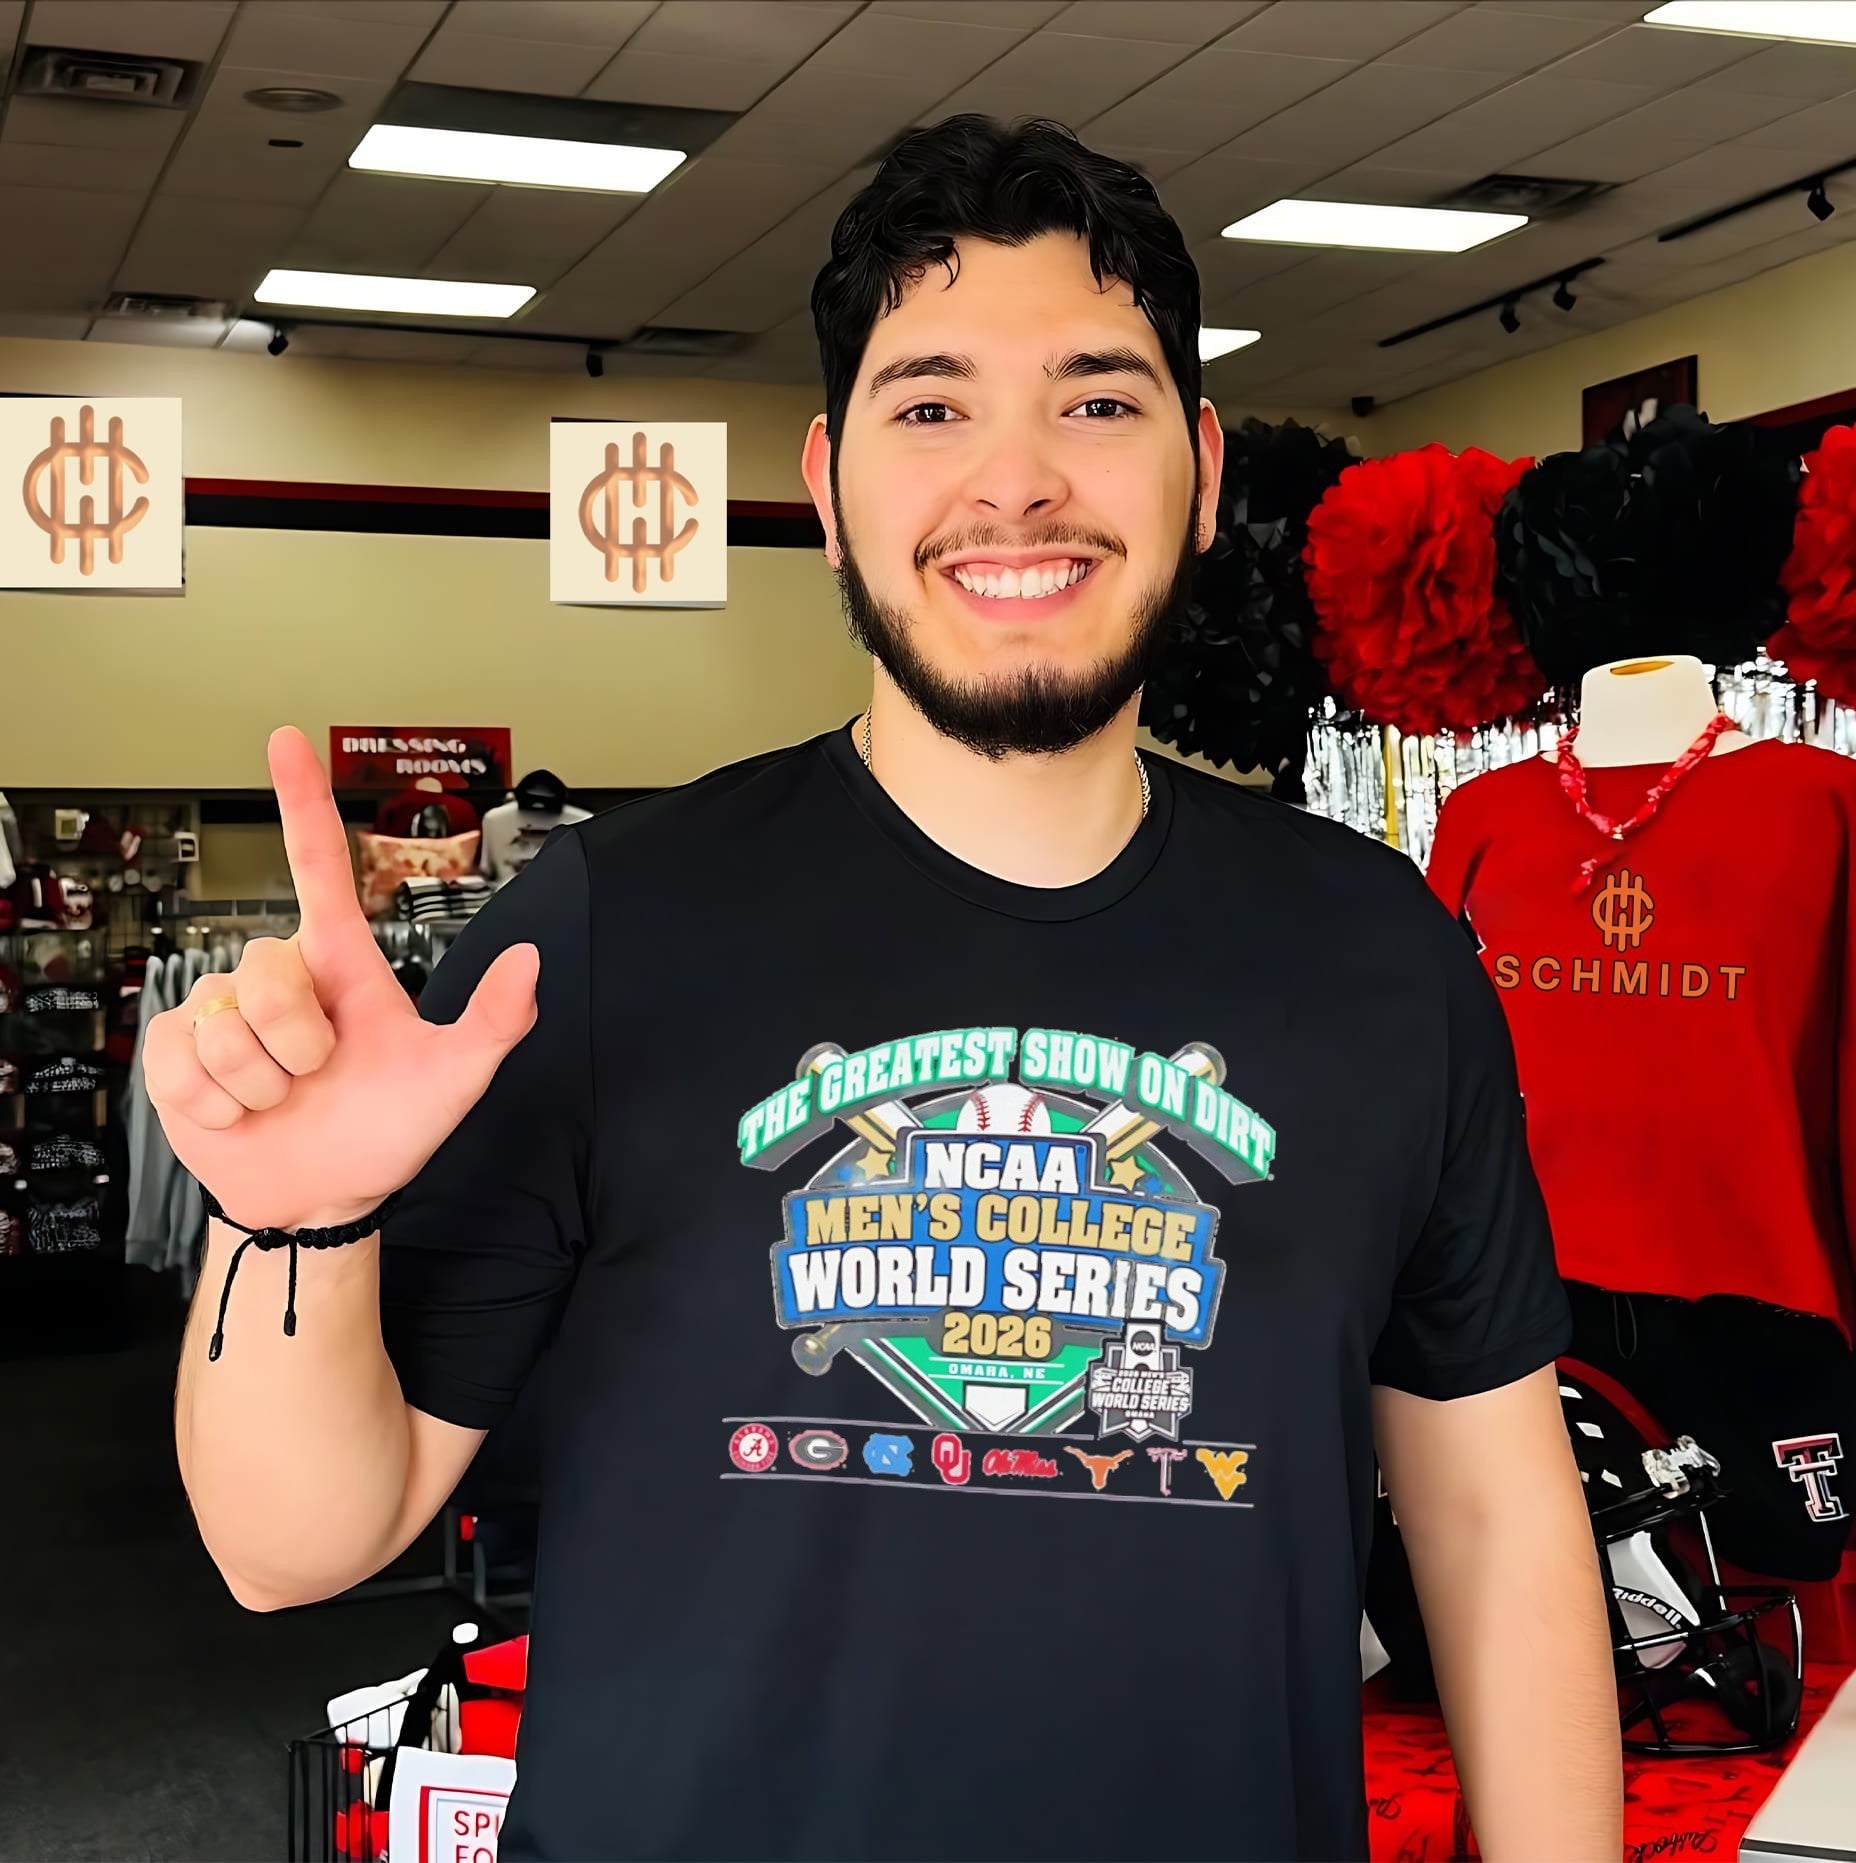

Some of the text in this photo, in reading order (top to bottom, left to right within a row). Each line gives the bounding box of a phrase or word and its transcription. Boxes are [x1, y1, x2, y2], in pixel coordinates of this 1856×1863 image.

[341, 736, 467, 754] DRESSING
[395, 758, 487, 774] ROOMS
[1493, 953, 1747, 1001] SCHMIDT
[740, 1029, 1275, 1175] THE GREATEST SHOW ON DIRT
[924, 1141, 1080, 1194] NCAA
[805, 1192, 1198, 1262] MEN'S COLLEGE
[788, 1245, 1203, 1332] WORLD SERIES
[942, 1311, 1052, 1359] 2026
[1023, 1367, 1046, 1379] NE
[1111, 1377, 1170, 1396] COLLEGE
[1091, 1392, 1190, 1412] WORLD SERIES
